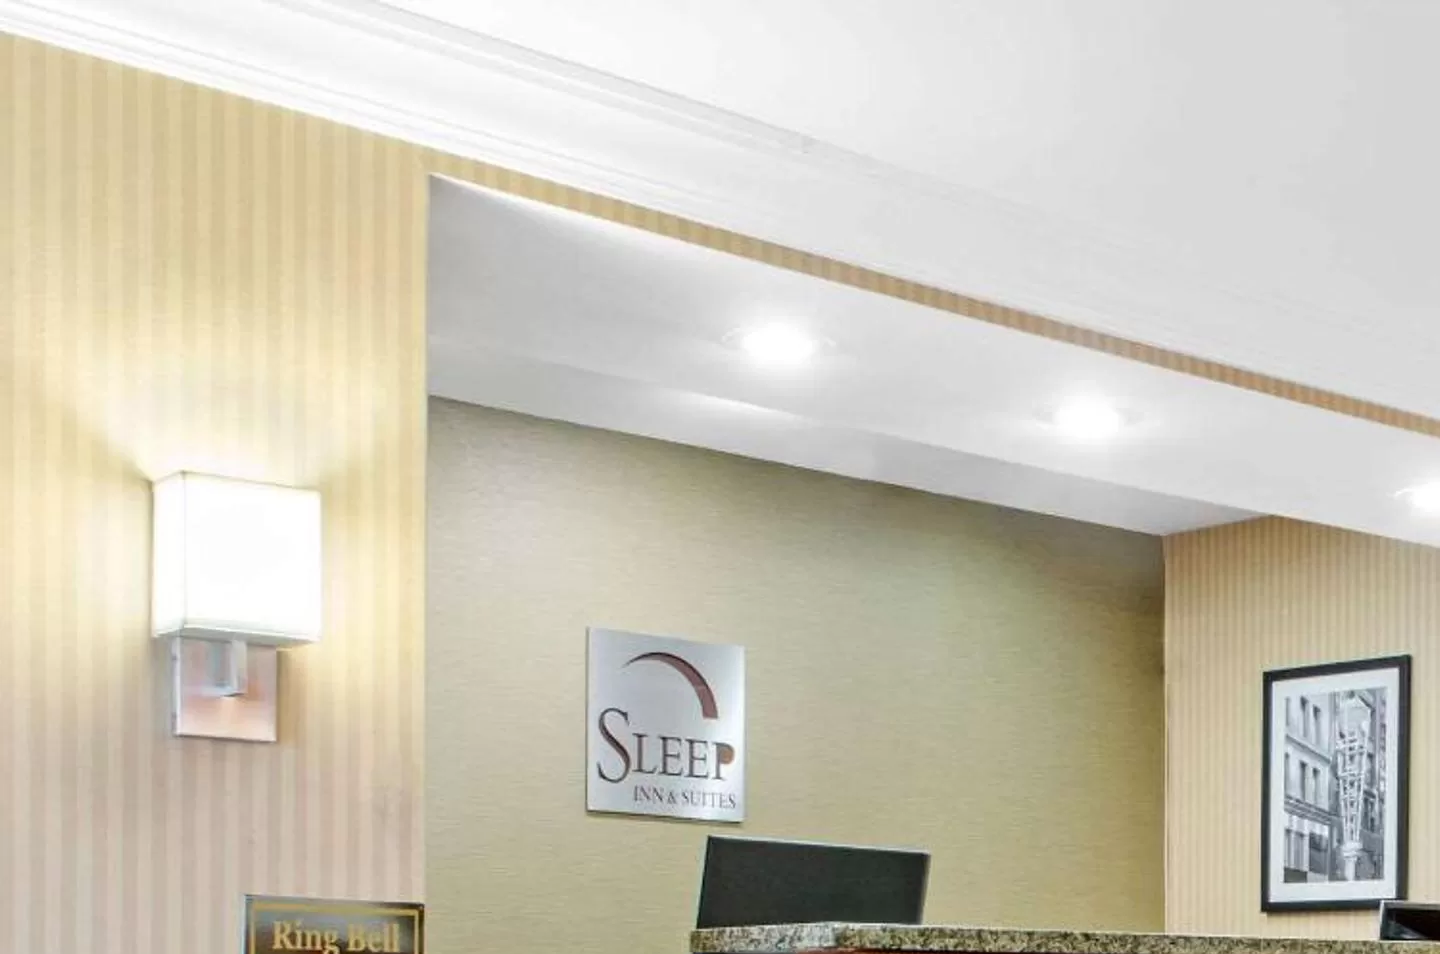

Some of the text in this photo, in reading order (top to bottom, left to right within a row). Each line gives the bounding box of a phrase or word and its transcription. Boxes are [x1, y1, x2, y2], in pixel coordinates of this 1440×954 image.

[597, 707, 735, 783] SLEEP
[634, 784, 736, 808] INN & SUITES
[347, 923, 399, 952] Bell
